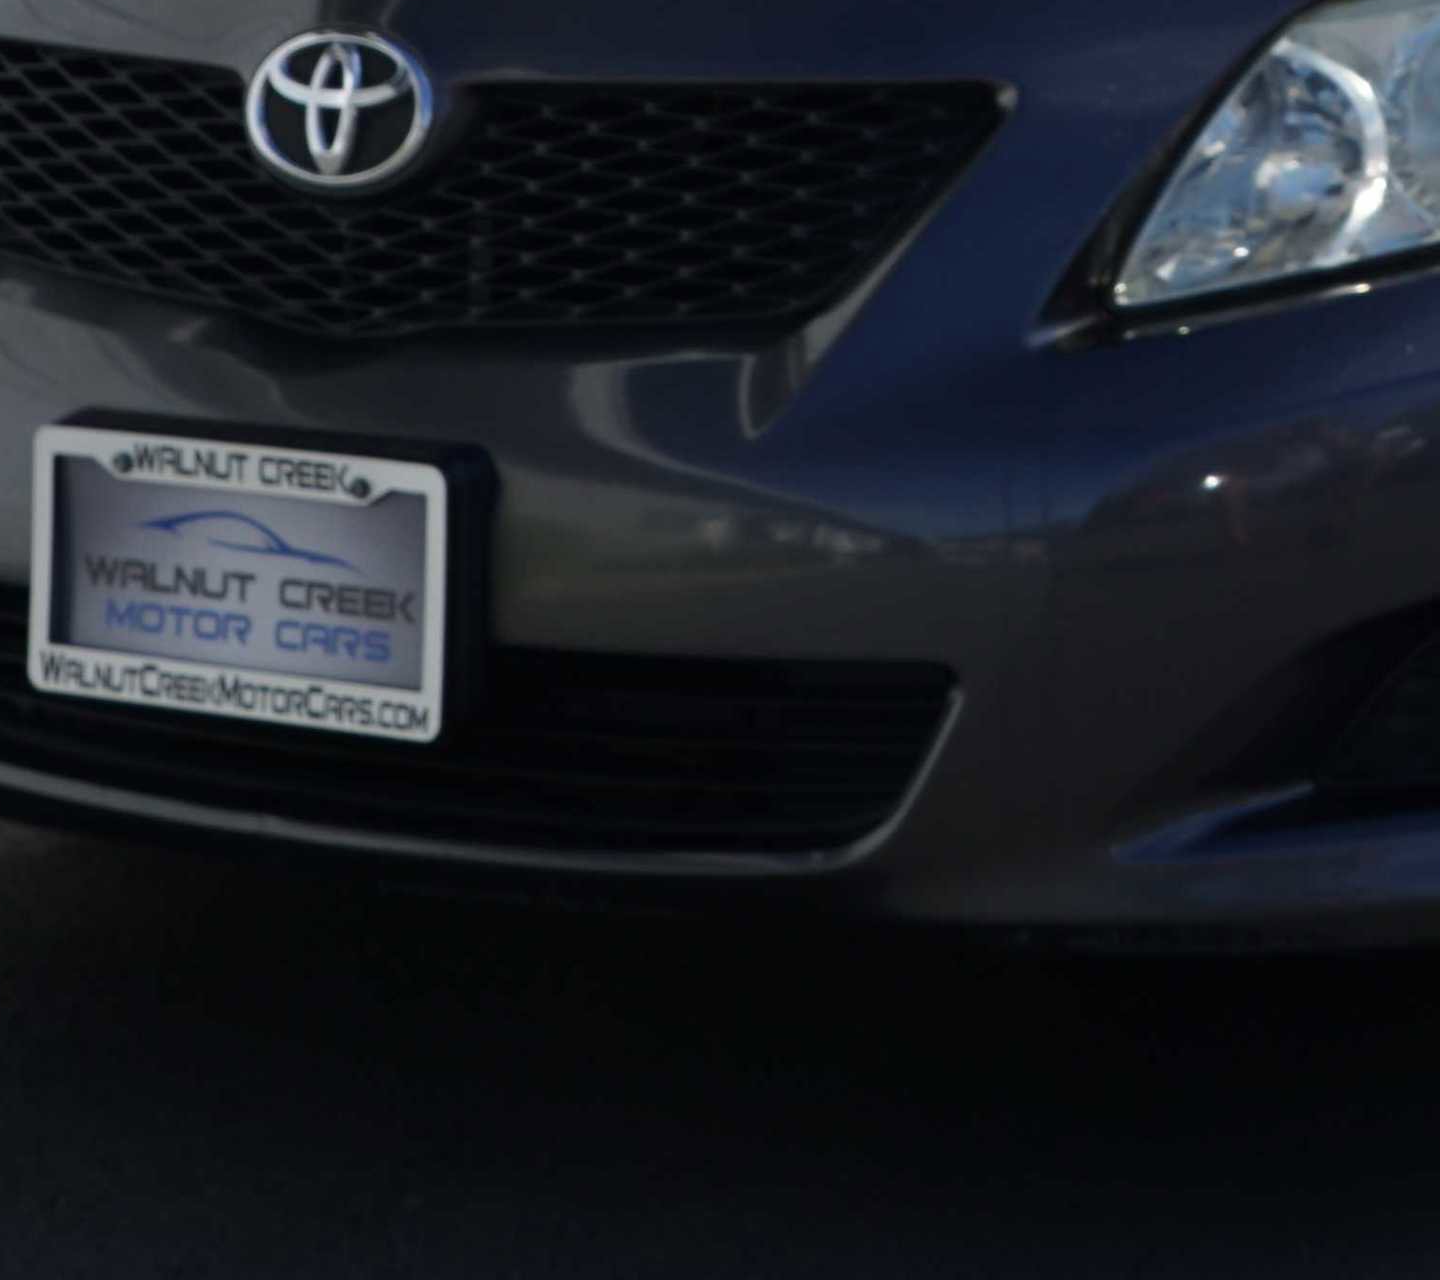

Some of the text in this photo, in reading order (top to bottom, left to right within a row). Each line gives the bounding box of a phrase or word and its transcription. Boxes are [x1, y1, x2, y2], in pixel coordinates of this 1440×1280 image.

[134, 443, 351, 493] WALNUT CREEK
[85, 555, 417, 624] WALNUT CREEK
[105, 600, 392, 663] MOTOR CARS
